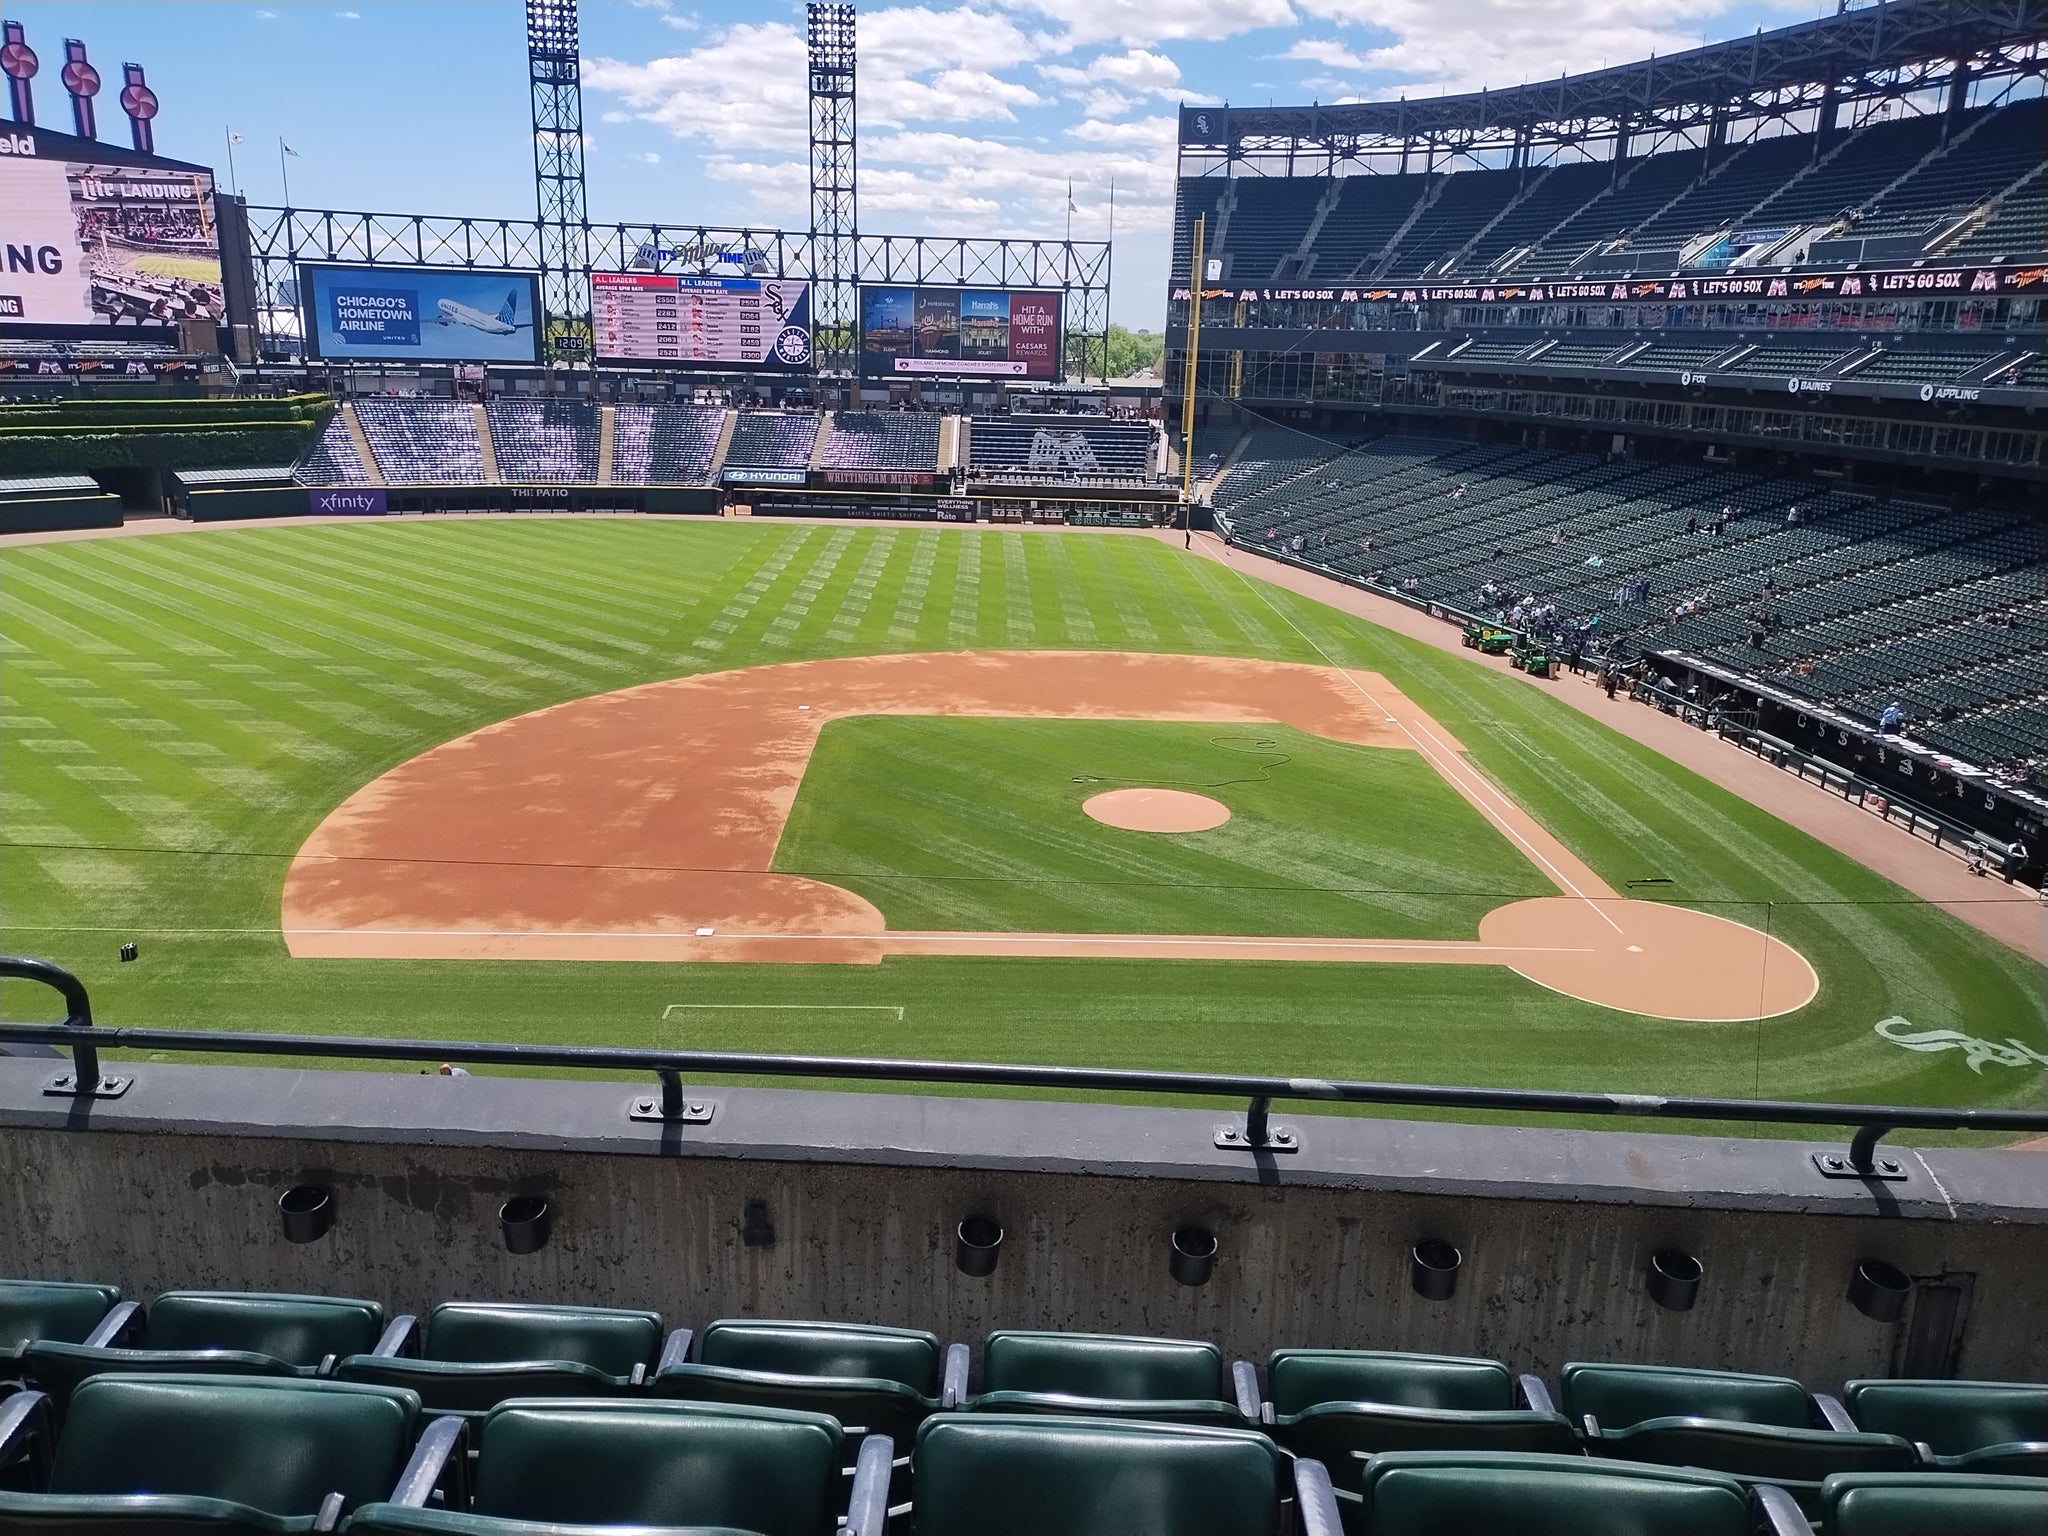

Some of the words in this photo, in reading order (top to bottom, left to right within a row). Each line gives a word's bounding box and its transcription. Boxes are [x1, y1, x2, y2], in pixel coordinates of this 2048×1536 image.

[120, 182, 192, 198] LANDING
[658, 250, 676, 260] IT'S
[673, 243, 729, 266] Miller
[717, 252, 743, 263] TIME
[1703, 282, 1728, 293] LET'S
[1729, 282, 1742, 293] GO
[1743, 280, 1763, 292] SOX
[1883, 275, 1915, 289] LET'S
[1917, 274, 1934, 288] GO
[1936, 273, 1962, 288] SOX
[1275, 291, 1300, 299] LET'S
[1302, 291, 1316, 299] GO
[1317, 291, 1334, 299] SOX
[1432, 290, 1454, 299] LET'S
[1455, 290, 1464, 298] GO
[1464, 289, 1477, 298] SOX
[1557, 286, 1577, 296] LET'S
[1578, 286, 1589, 296] GO
[1590, 285, 1606, 296] SOX
[337, 296, 406, 308] CHICAGO'S
[338, 308, 412, 320] HOMETOWN
[1012, 314, 1035, 326] HOME
[1037, 314, 1054, 326] RUN
[340, 321, 385, 331] AIRLINE
[1021, 326, 1044, 334] WITH
[1692, 375, 1706, 384] FOX
[1801, 382, 1831, 391] BAINES
[1935, 388, 1980, 399] APPLING
[750, 473, 801, 481] HYUNDAI
[827, 472, 886, 484] WHITTINGHAM
[890, 475, 918, 484] MEATS
[320, 494, 374, 512] xfinity
[937, 511, 956, 520] Rate
[1084, 517, 1106, 525] RUSH
